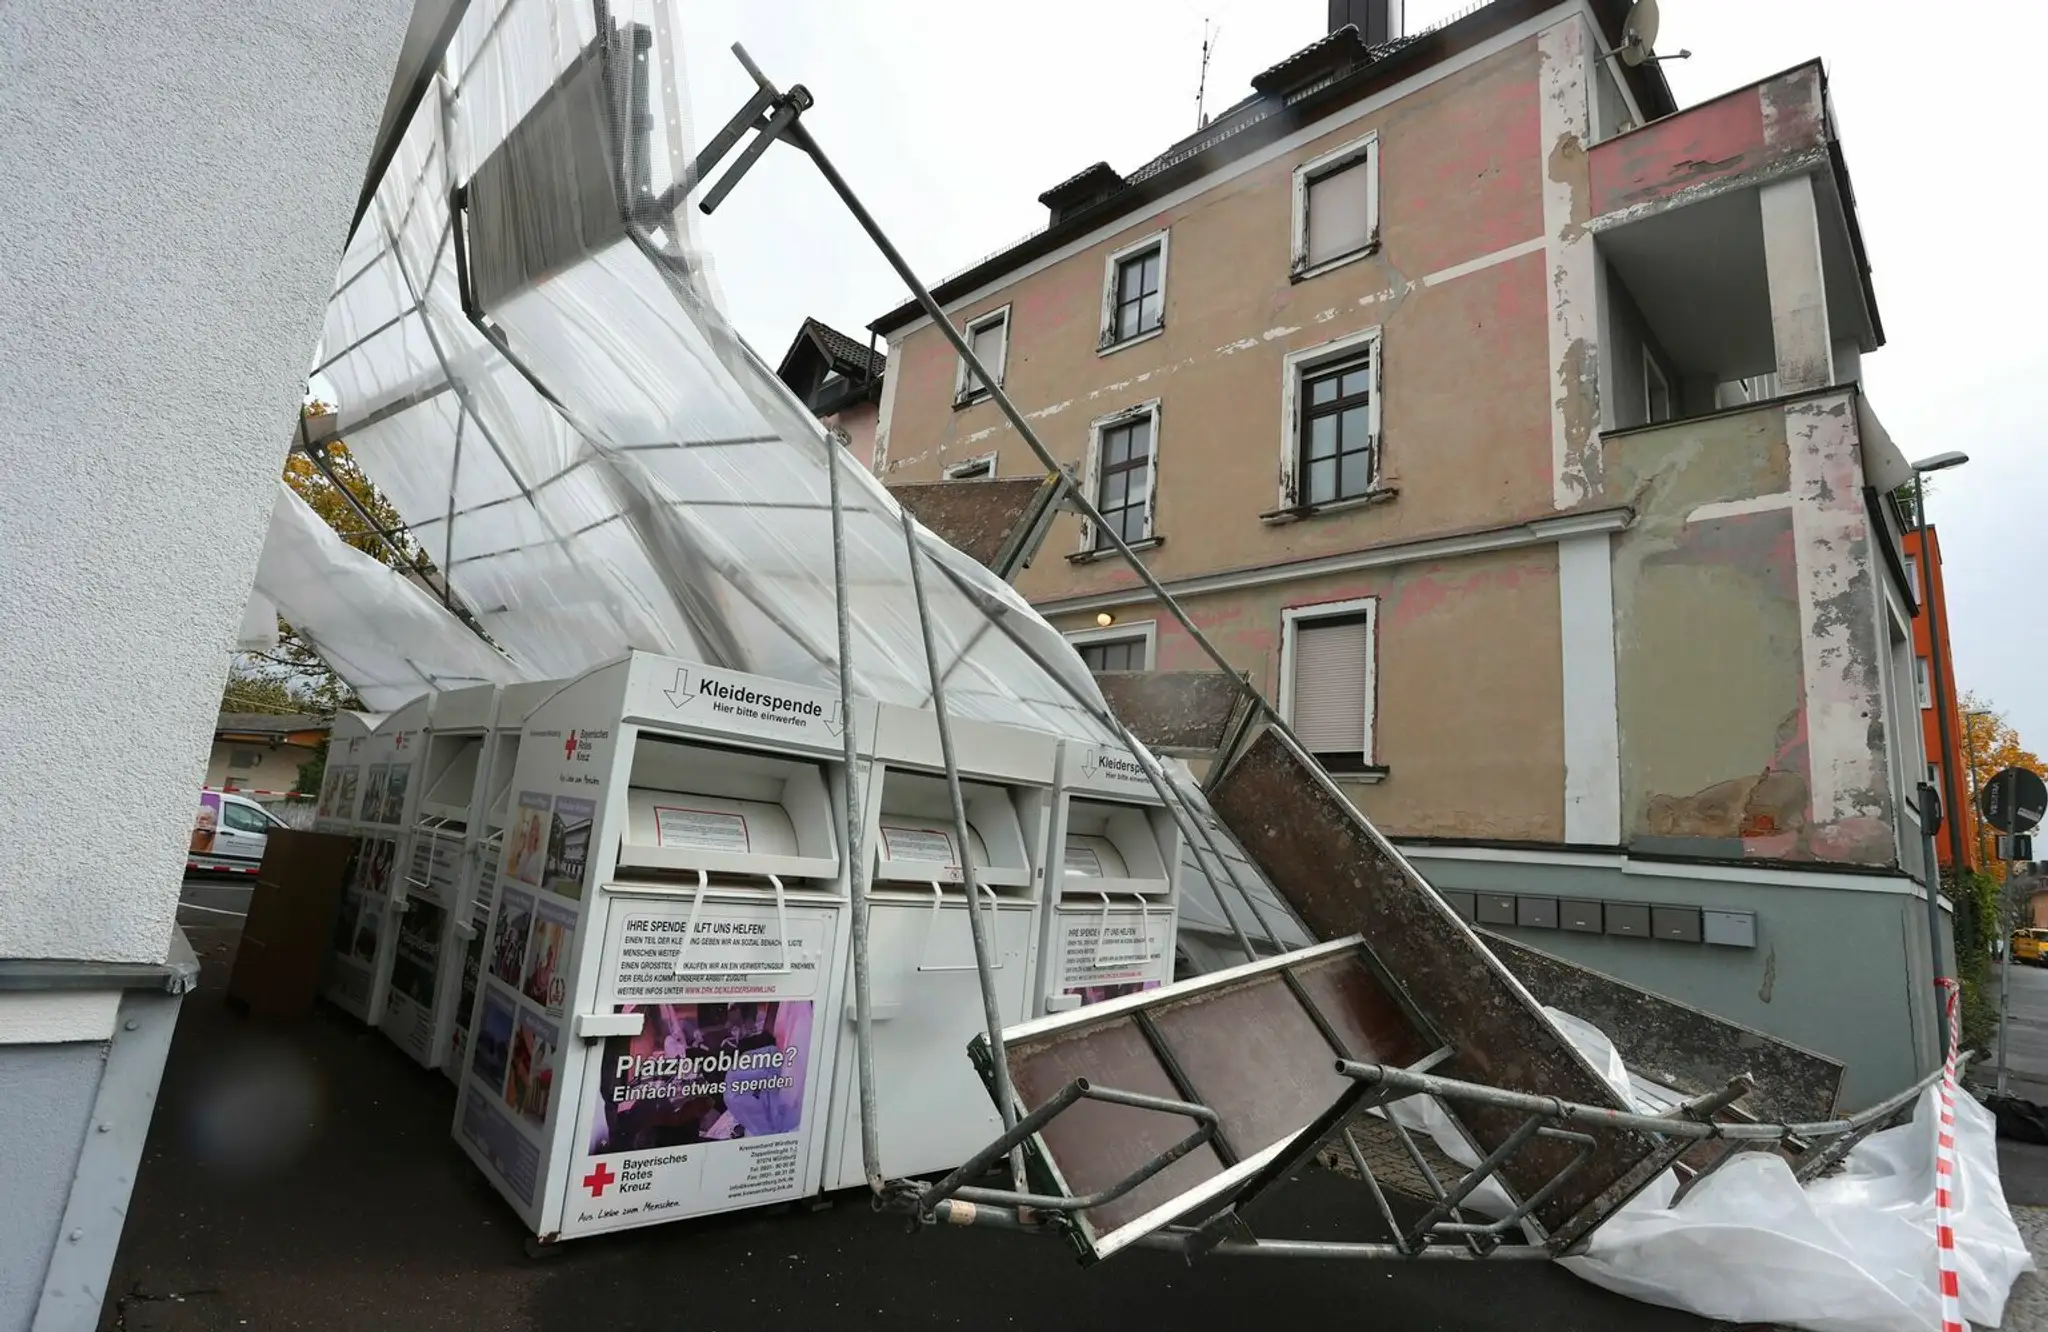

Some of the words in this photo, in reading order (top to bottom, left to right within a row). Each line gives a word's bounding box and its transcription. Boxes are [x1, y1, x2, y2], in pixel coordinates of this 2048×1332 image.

[700, 679, 822, 716] Kleiderspende
[713, 701, 734, 714] Hier
[736, 706, 758, 719] bitte
[761, 711, 807, 727] einwerfen
[1099, 756, 1146, 775] Kleiderspe
[627, 920, 649, 932] IHRE
[650, 921, 687, 932] SPENDE
[694, 923, 712, 933] ILFT
[713, 923, 731, 934] UNS
[732, 923, 767, 935] HELFEN!
[625, 936, 643, 944] EINEN
[644, 936, 656, 944] TEIL
[657, 936, 670, 945] DER
[732, 938, 740, 946] AN
[623, 949, 656, 957] MENSCHEN
[621, 961, 639, 969] EINEN
[641, 961, 672, 970] GROSSTEIL
[617, 987, 643, 995] WEITERE
[645, 987, 662, 995] INFOS
[664, 986, 684, 995] UNTER
[616, 1046, 798, 1079] Platzprobleme?
[612, 1084, 676, 1102] Einfach
[682, 1081, 727, 1096] etwas
[731, 1075, 793, 1094] spenden
[623, 1154, 688, 1170] Bayerisches
[621, 1170, 653, 1182] Rotes
[619, 1182, 651, 1193] Kreuz
[577, 1212, 593, 1222] Aus
[598, 1209, 619, 1219] Liebe
[622, 1207, 638, 1215] zum
